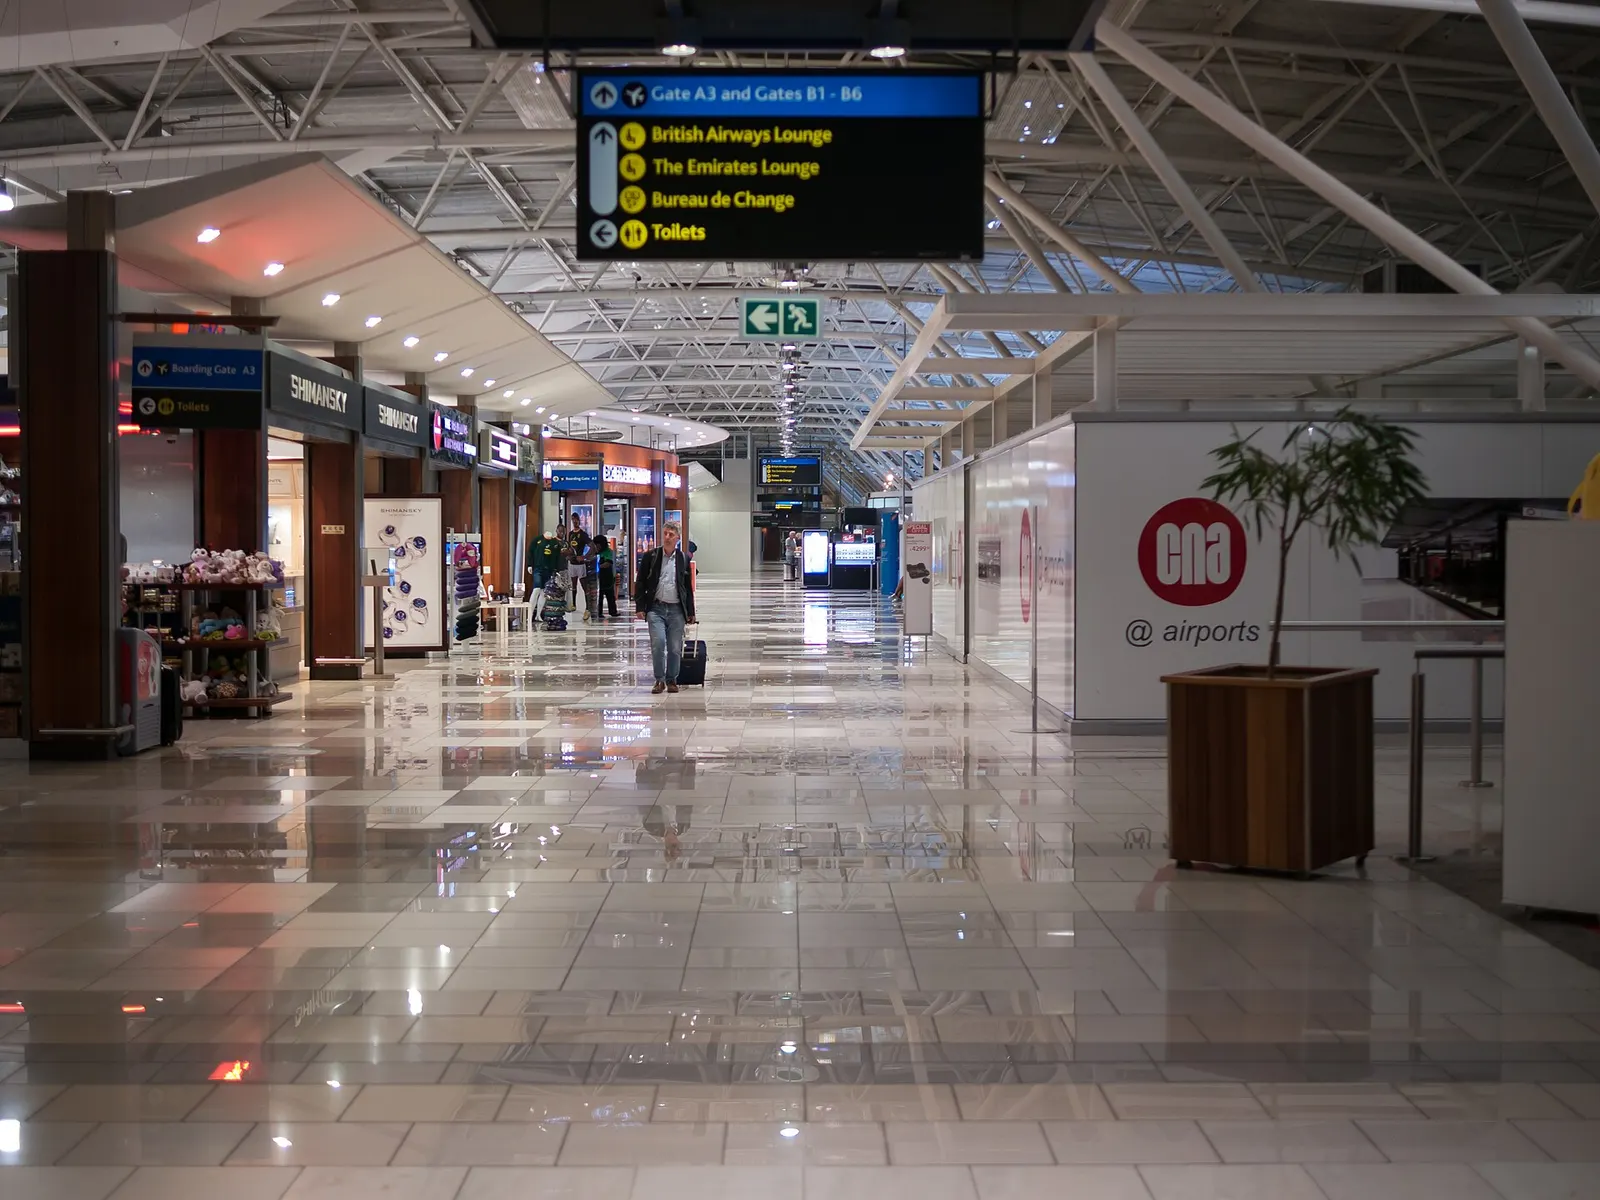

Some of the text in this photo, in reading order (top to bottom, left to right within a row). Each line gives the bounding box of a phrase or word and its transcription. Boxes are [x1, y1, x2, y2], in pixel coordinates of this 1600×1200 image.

[651, 85, 691, 102] Gate
[694, 86, 716, 101] A3
[721, 85, 751, 102] and
[754, 85, 803, 102] Gates
[806, 85, 825, 102] B1
[841, 85, 863, 102] B6
[652, 125, 833, 148] British Airways Lounge
[652, 157, 820, 180] The Emirates Lounge
[652, 190, 795, 213] Bureau de Change
[651, 222, 706, 241] Toilets
[171, 363, 256, 377] Boarding Gate A3
[290, 374, 348, 414] SHIMANSKY
[176, 401, 210, 412] Toilets
[378, 403, 419, 434] SHIMANSKY
[1156, 521, 1231, 586] cna
[1126, 619, 1260, 647] @ airports
